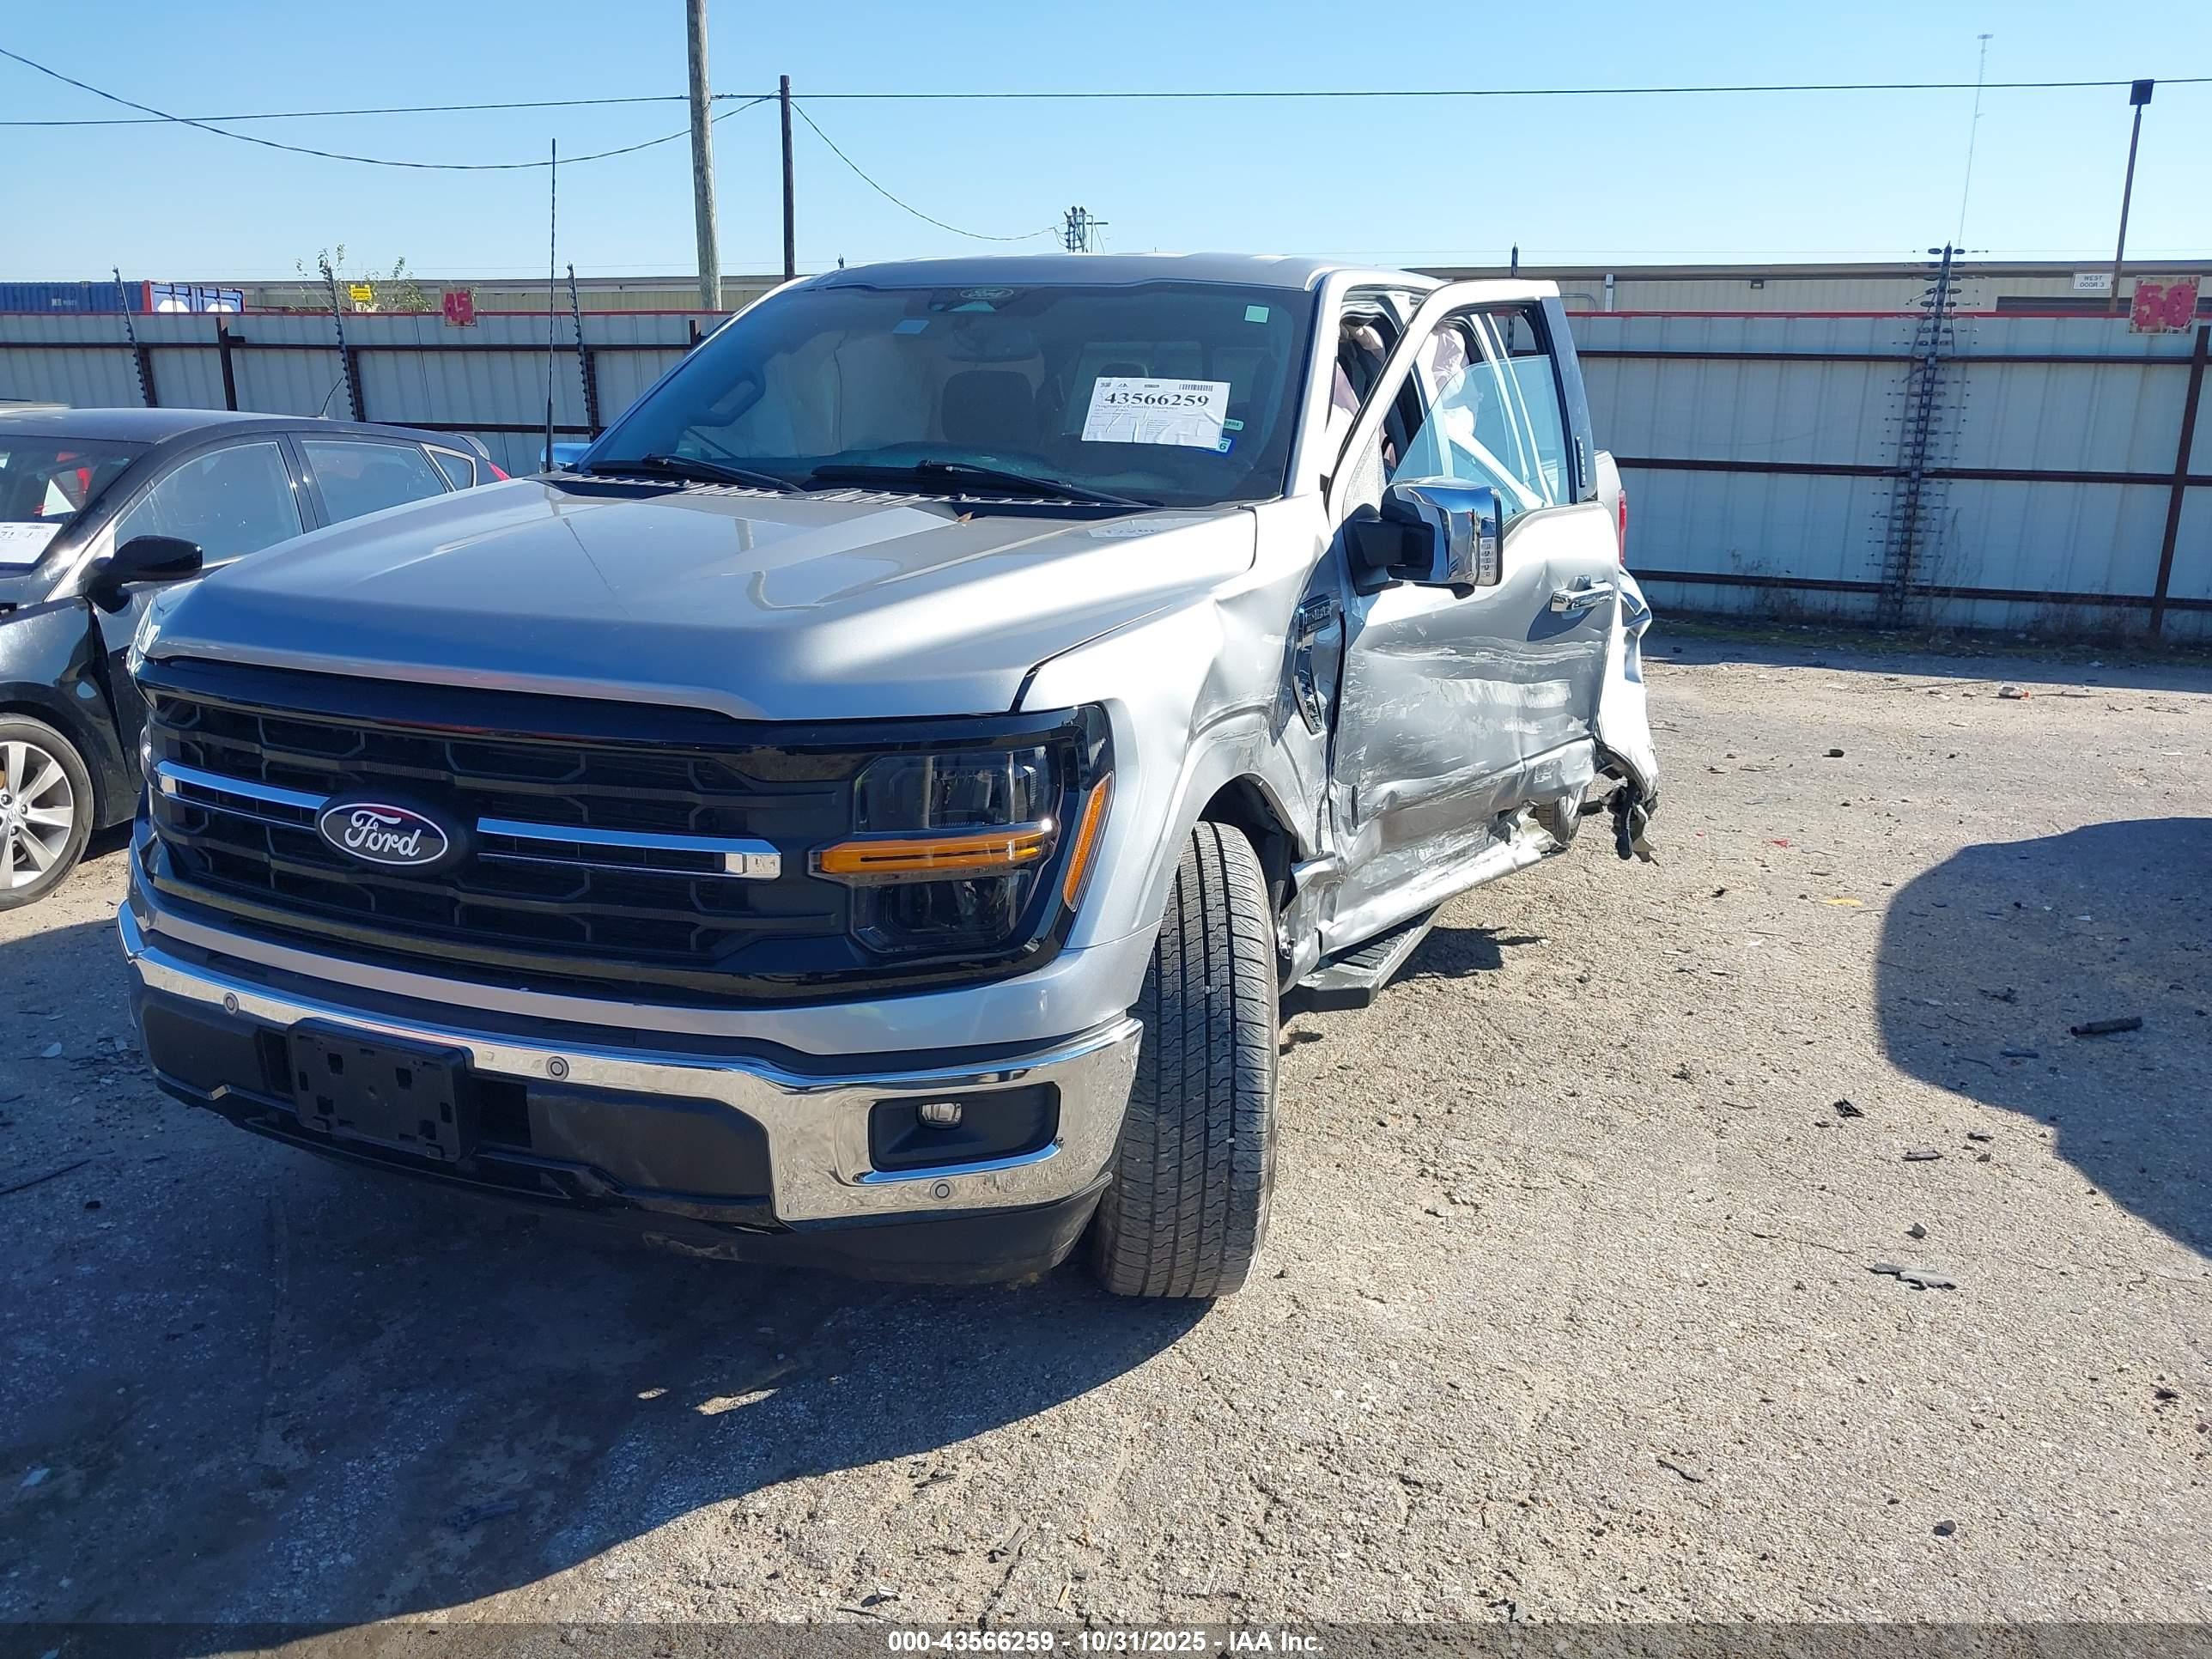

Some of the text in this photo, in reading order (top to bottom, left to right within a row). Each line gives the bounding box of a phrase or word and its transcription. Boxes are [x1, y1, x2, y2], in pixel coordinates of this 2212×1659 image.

[2135, 283, 2195, 328] 50
[1104, 392, 1210, 407] 43566259
[344, 810, 422, 857] Ford
